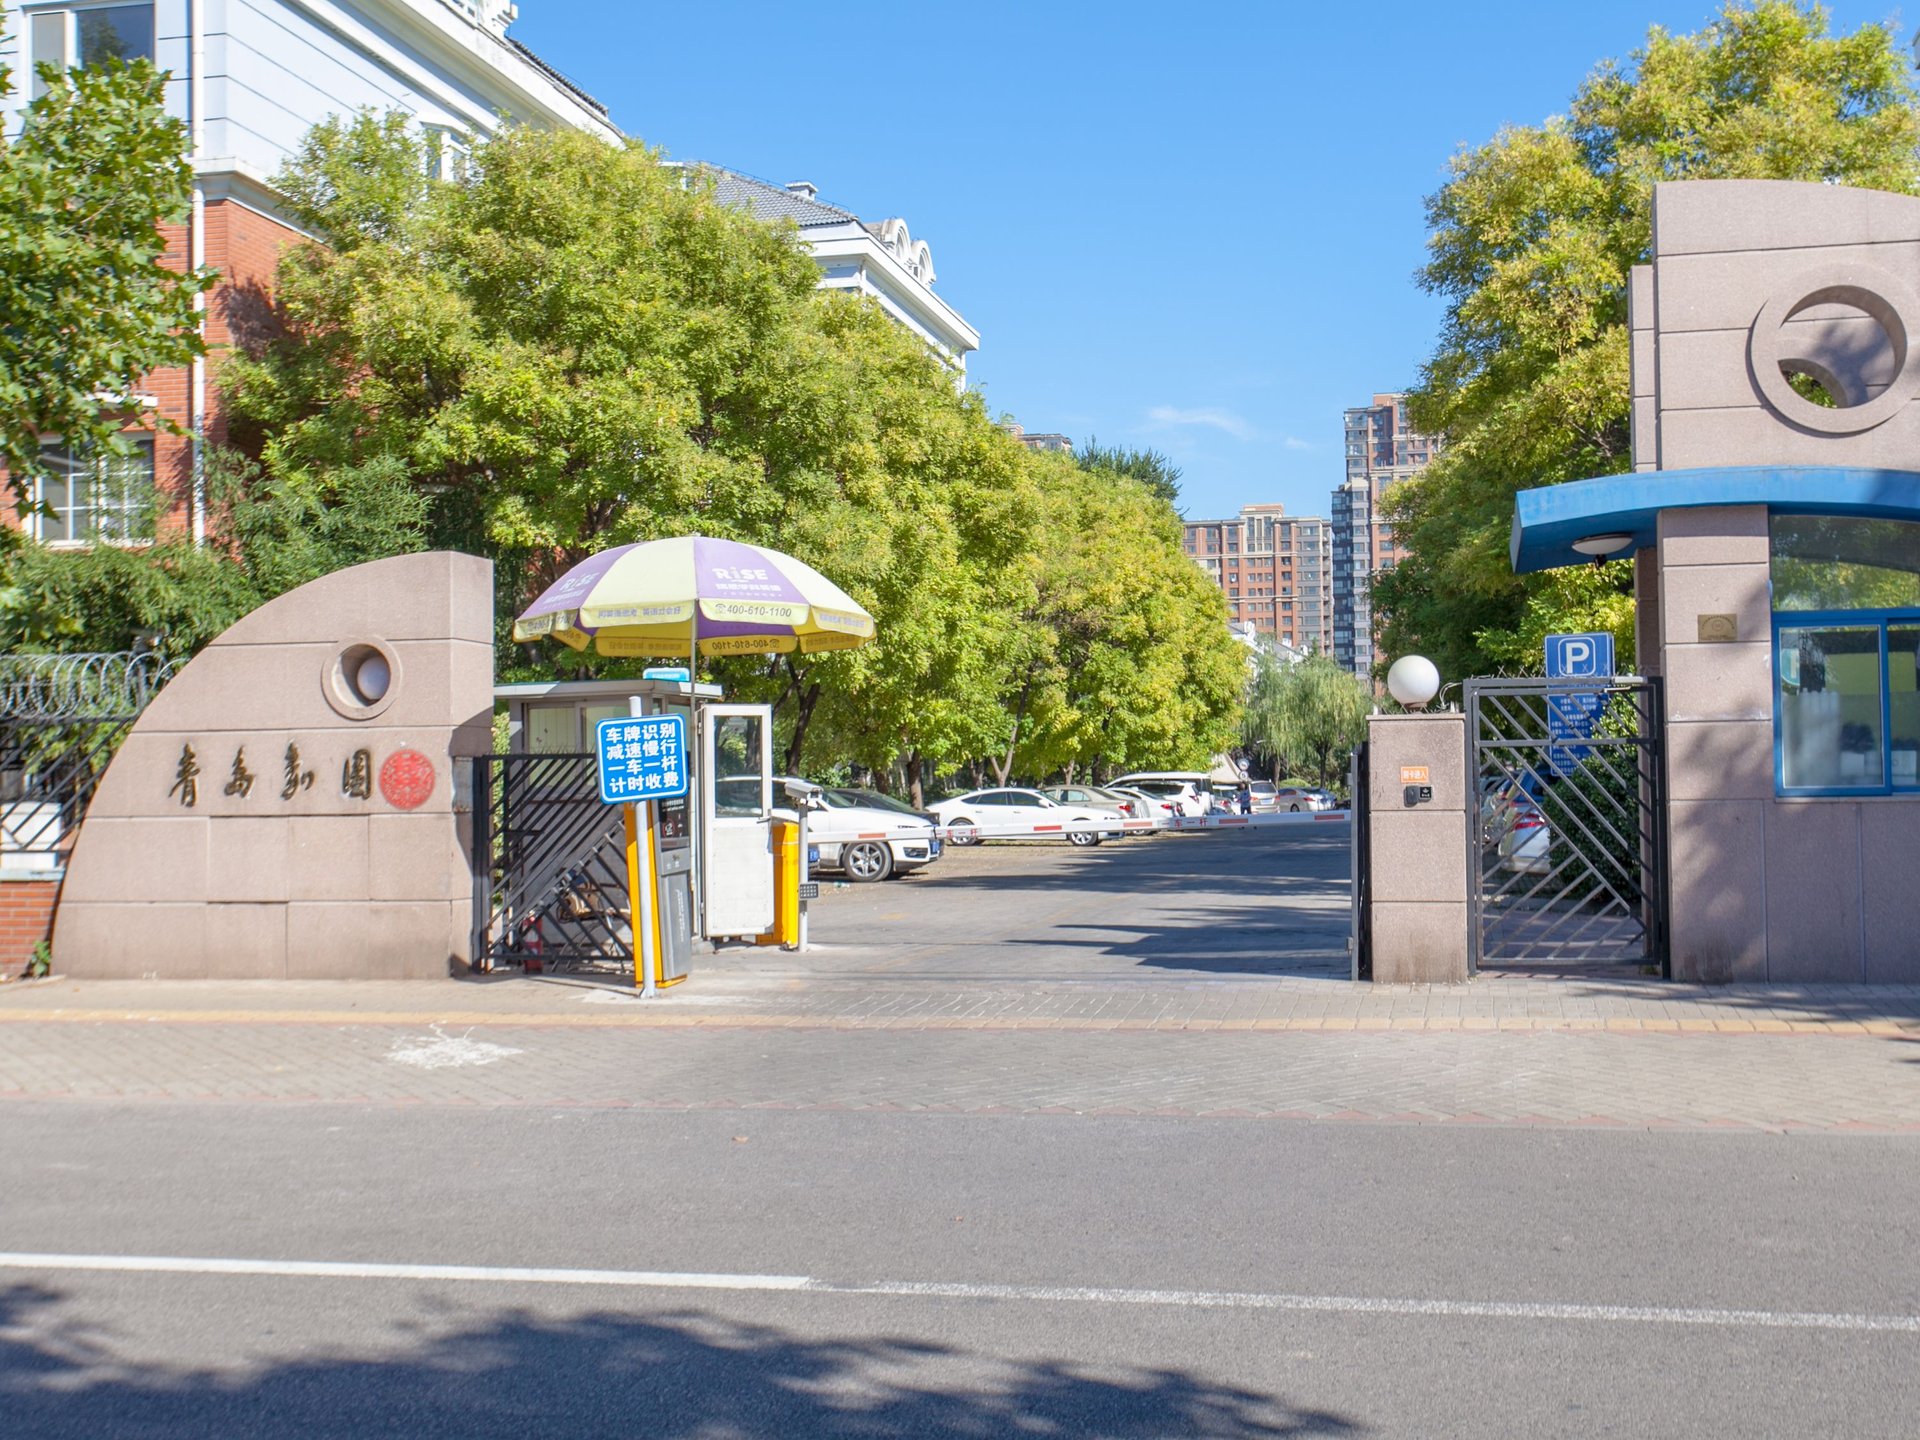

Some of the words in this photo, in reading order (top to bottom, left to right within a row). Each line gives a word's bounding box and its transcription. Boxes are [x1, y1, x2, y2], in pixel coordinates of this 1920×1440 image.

[727, 605, 792, 617] 400-610-1100
[1566, 642, 1590, 674] P
[605, 722, 676, 743] 车牌识别
[606, 739, 677, 760] 减速慢行
[608, 755, 678, 775] 一车一杆
[609, 771, 679, 794] 计时收费
